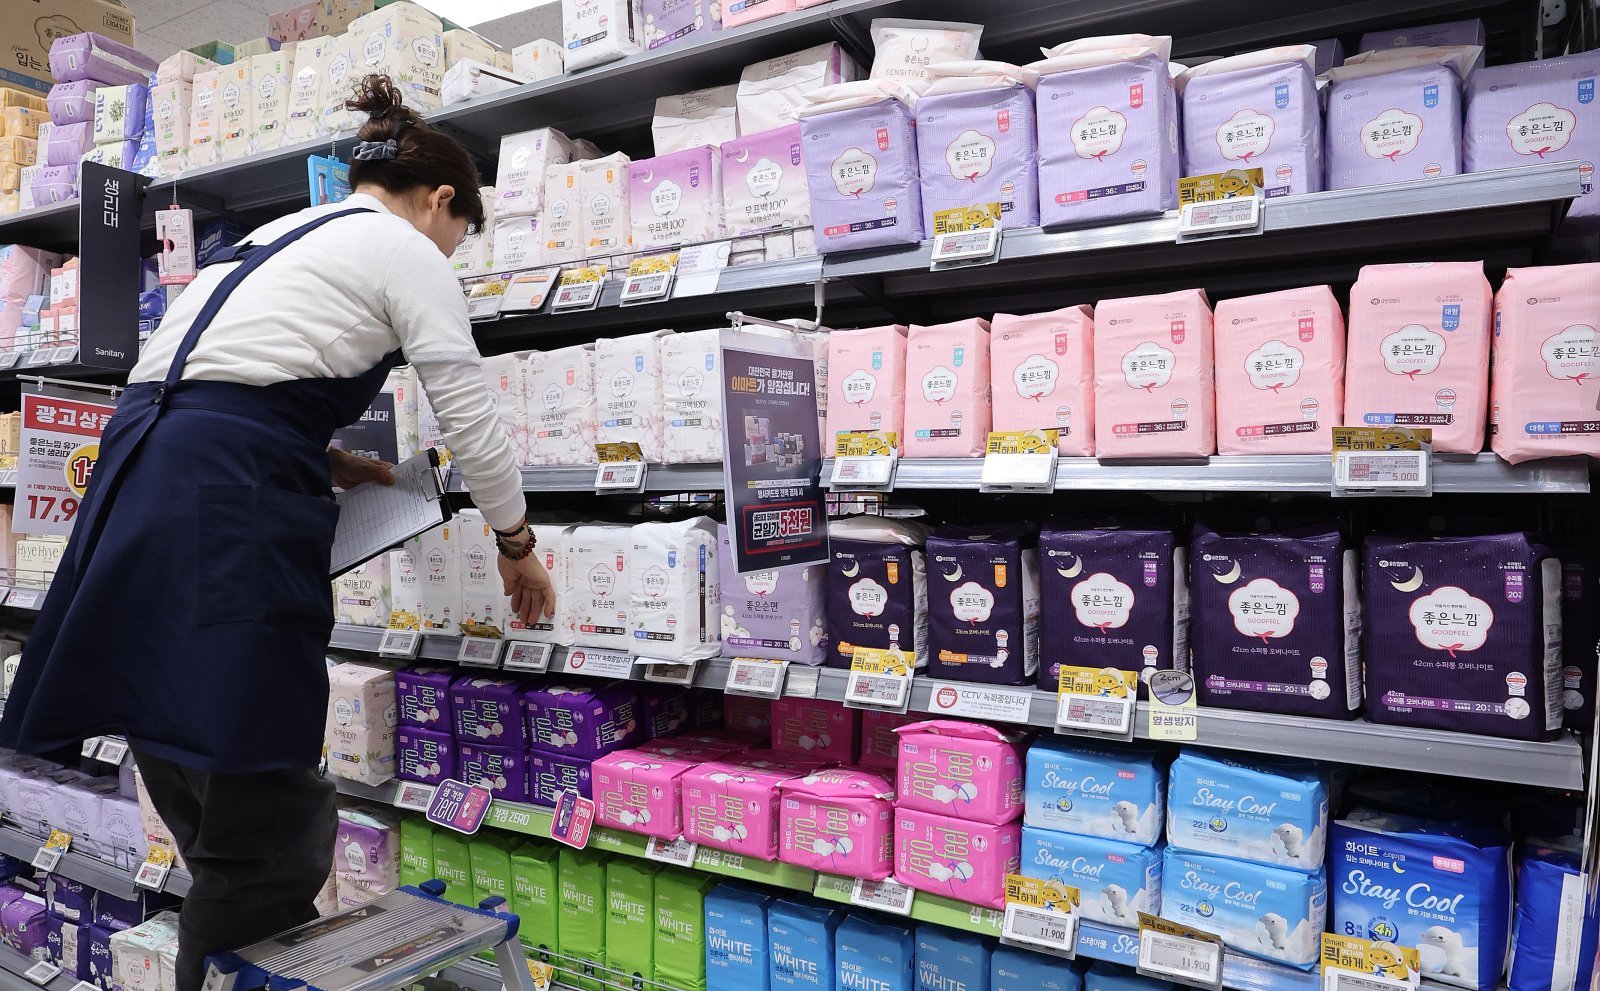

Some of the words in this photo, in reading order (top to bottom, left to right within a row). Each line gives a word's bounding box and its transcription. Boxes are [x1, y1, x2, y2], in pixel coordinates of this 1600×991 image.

[16, 52, 42, 69] 입는
[904, 55, 930, 65] 좋은느낌
[885, 68, 925, 78] SENSITIVE
[1579, 82, 1592, 91] 대형
[1080, 124, 1118, 140] 좋은느낌
[1226, 126, 1265, 142] 좋은느낌
[1371, 125, 1412, 141] 좋은느낌
[1518, 121, 1564, 136] 좋은느낌
[954, 147, 987, 161] 좋은느낌
[839, 165, 870, 177] 좋은느낌
[752, 172, 777, 186] 좋은느낌
[103, 178, 119, 229] 생리대
[1445, 307, 1458, 316] 대형
[95, 347, 125, 359] Sanitary
[1391, 344, 1435, 356] 좋은느낌
[1130, 360, 1166, 372] 좋은느낌
[1254, 358, 1295, 371] 좋은느낌
[748, 366, 769, 378] 대한민국
[771, 369, 794, 380] 물가안정
[1021, 370, 1051, 382] 좋은느낌
[732, 378, 765, 393] 이마트가
[767, 380, 810, 397] 앞장섭니다!
[847, 382, 871, 391] 좋은느낌
[926, 380, 952, 389] 좋은느낌
[1368, 414, 1381, 423] 대형
[1530, 424, 1544, 433] 대형
[30, 437, 61, 448] 좋은느낌
[62, 441, 81, 450] 유기
[30, 448, 46, 456] 순면
[48, 449, 69, 458] 생리대
[753, 521, 780, 540] 균일가
[780, 508, 812, 538] 5천원
[592, 599, 615, 609] 좋은순면
[856, 592, 881, 602] 좋은느낌
[958, 596, 988, 608] 좋은느낌
[1082, 595, 1123, 608] 좋은느낌
[643, 599, 668, 610] 좋은순면
[746, 599, 779, 612] 좋은순면
[1240, 601, 1287, 615] 좋은느낌
[1247, 617, 1281, 625] GOODFEEL
[1423, 611, 1479, 627] 좋은느낌
[1432, 629, 1470, 637] GOODFEEL
[1232, 646, 1249, 654] 42cm
[1251, 647, 1268, 655] 수퍼롱
[1269, 647, 1300, 656] 오버나이트
[587, 652, 601, 661] CCTV
[602, 653, 631, 665] 녹화중입니다
[1413, 659, 1433, 668] 42cm
[1435, 659, 1456, 670] 수퍼롱
[1458, 662, 1494, 671] 오버나이트
[1160, 674, 1182, 682] 2cm
[961, 691, 981, 700] CCTV
[983, 694, 1027, 707] 녹화중입니다
[1387, 697, 1404, 705] 수퍼롱
[1406, 698, 1435, 707] 오버나이트
[1152, 715, 1195, 727] 옆샘방지
[1043, 762, 1061, 770] 화이트
[1041, 770, 1078, 798] Stay
[1080, 776, 1115, 796] Cool
[1192, 788, 1235, 814] Stay
[1236, 795, 1277, 818] Cool
[508, 810, 529, 826] ZERO
[1345, 841, 1380, 857] 화이트
[404, 853, 428, 869] WHITE
[723, 853, 744, 870] FEEL
[1034, 849, 1070, 875] Stay
[1071, 857, 1105, 877] Cool
[1346, 855, 1358, 863] 입는
[1359, 858, 1390, 870] 오버나이트
[437, 866, 466, 881] WHITE
[475, 875, 505, 890] WHITE
[1181, 871, 1220, 898] Stay
[1222, 881, 1263, 905] Cool
[515, 882, 546, 898] WHITE
[1342, 870, 1401, 910] Stay
[1406, 882, 1465, 916] Cool
[563, 890, 594, 907] WHITE
[610, 899, 645, 916] WHITE
[1408, 908, 1419, 916] 쿨한
[1432, 913, 1455, 923] 오래오래
[659, 918, 693, 935] WHITE
[708, 927, 727, 935] 화이트
[1344, 920, 1354, 936] 8
[1373, 924, 1392, 937] 4h
[709, 936, 752, 956] WHITE
[1080, 936, 1107, 950] 스테이쿨
[1112, 935, 1139, 955] Sta
[773, 950, 817, 971] WHITE
[841, 970, 890, 991] WHITE
[920, 969, 967, 991] WHITE
